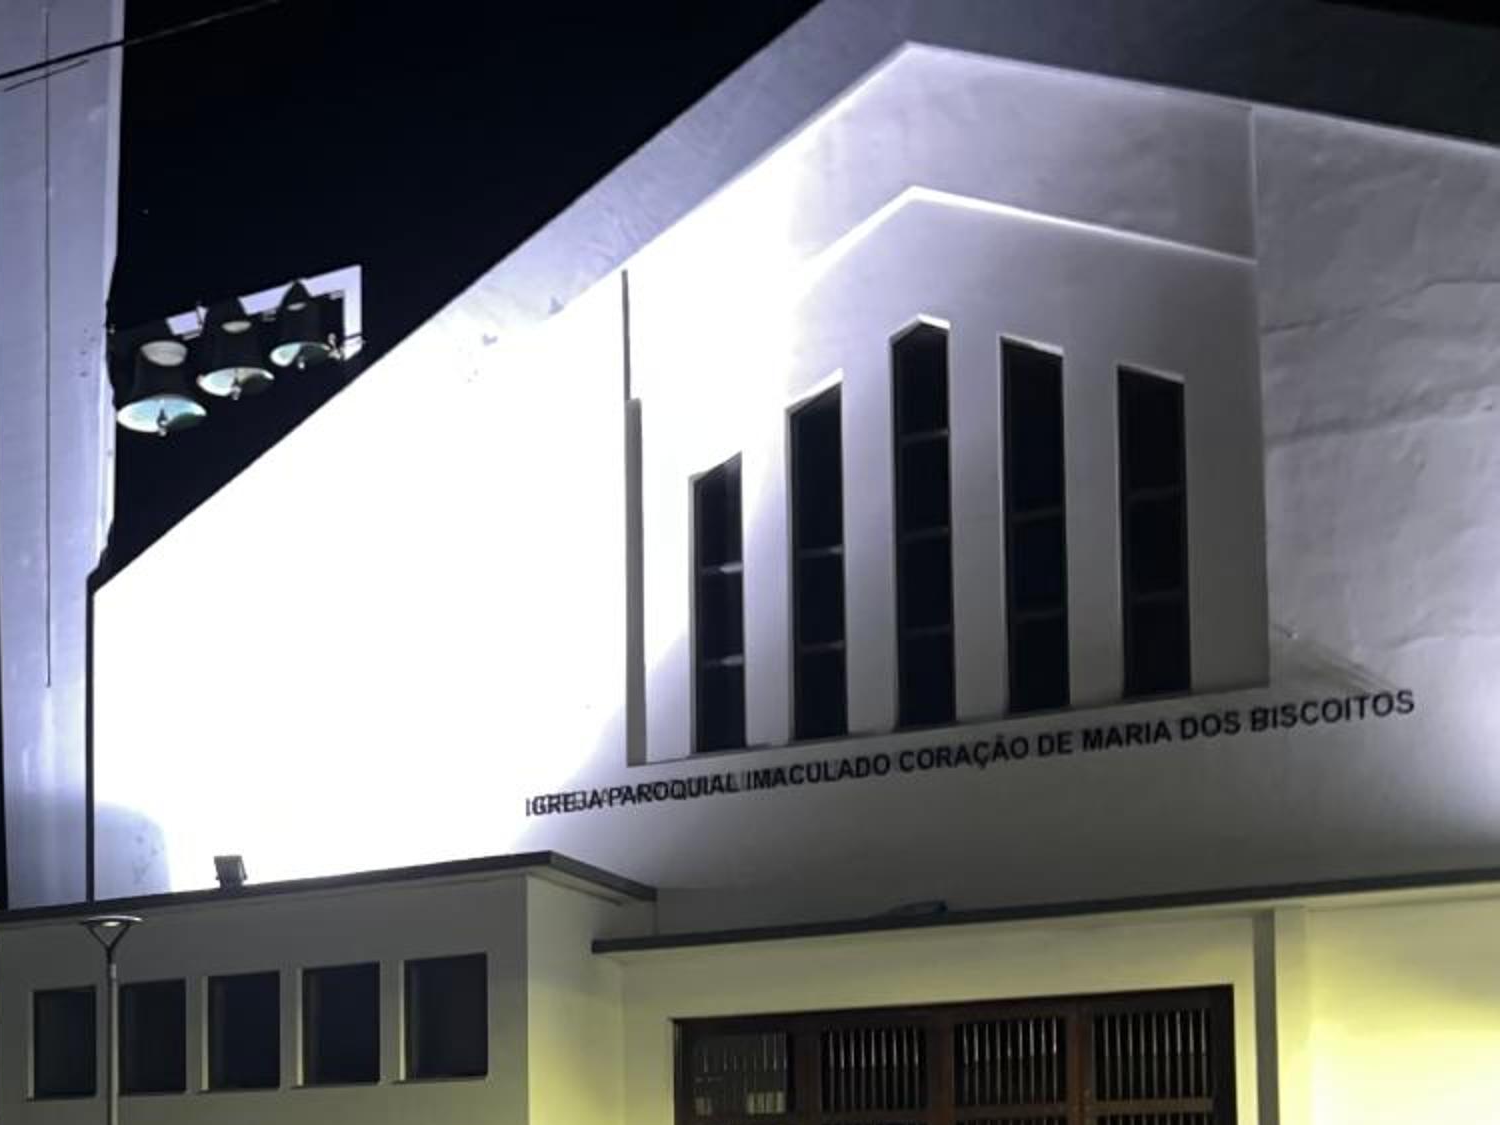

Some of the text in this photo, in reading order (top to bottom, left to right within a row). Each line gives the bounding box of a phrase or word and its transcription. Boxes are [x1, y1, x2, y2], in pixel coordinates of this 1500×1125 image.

[526, 690, 1415, 816] IGREJA PAROQUIAL IMACULADO CORAÇÃO DE MARIA DOS BISCOITOS
